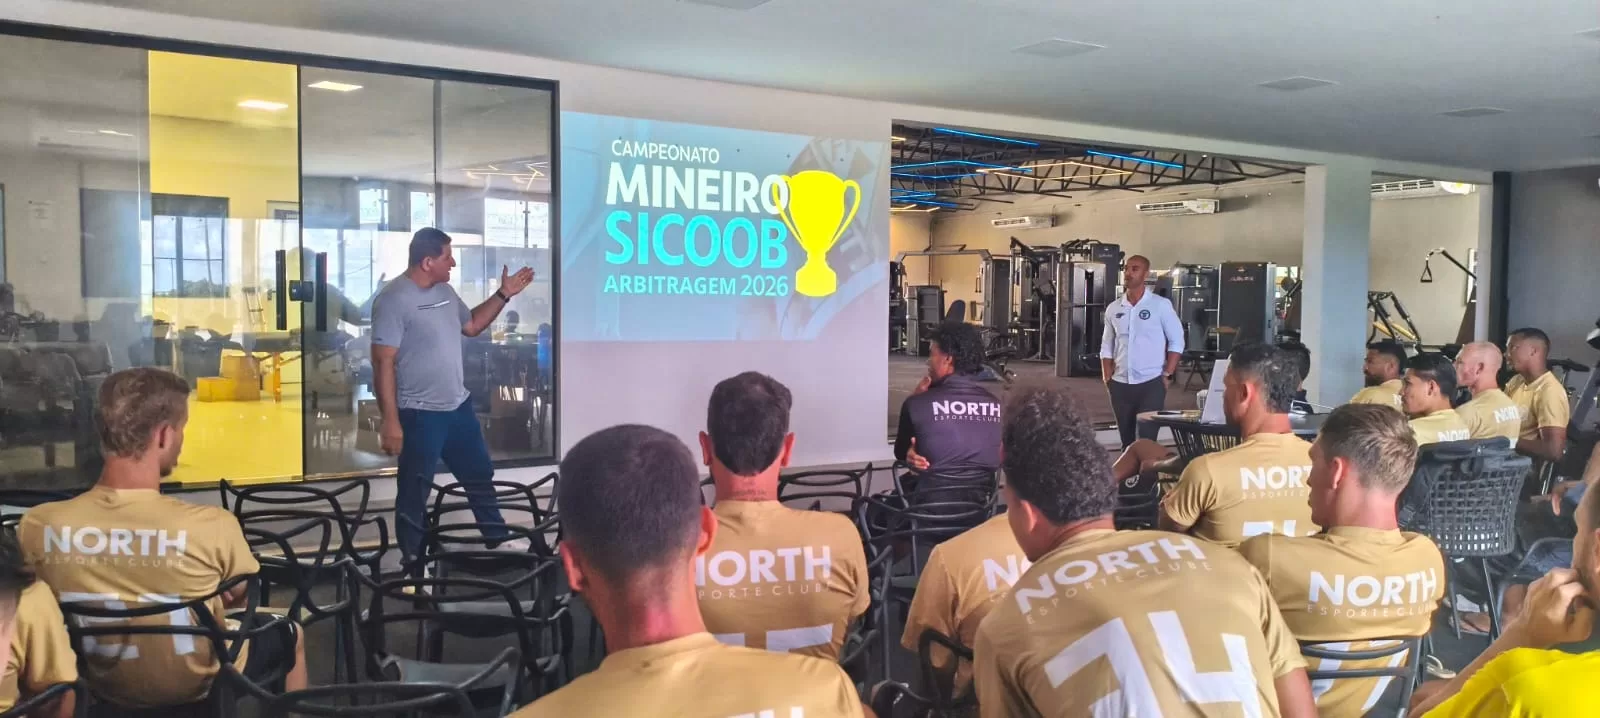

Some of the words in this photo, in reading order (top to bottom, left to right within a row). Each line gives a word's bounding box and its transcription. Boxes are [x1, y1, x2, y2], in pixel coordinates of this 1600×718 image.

[611, 139, 720, 164] CAMPEONATO
[605, 161, 789, 215] MINEIRO
[604, 210, 788, 269] SICOOB
[603, 274, 736, 295] ARBITRAGEM
[740, 274, 789, 297] 2026
[932, 399, 1001, 418] NORTH
[43, 525, 187, 557] NORTH
[1015, 537, 1207, 615] NORTH
[1136, 560, 1213, 578] CLUBE
[698, 586, 763, 600] PORTE
[772, 582, 822, 597] CLUB
[1308, 567, 1437, 607] NORTH
